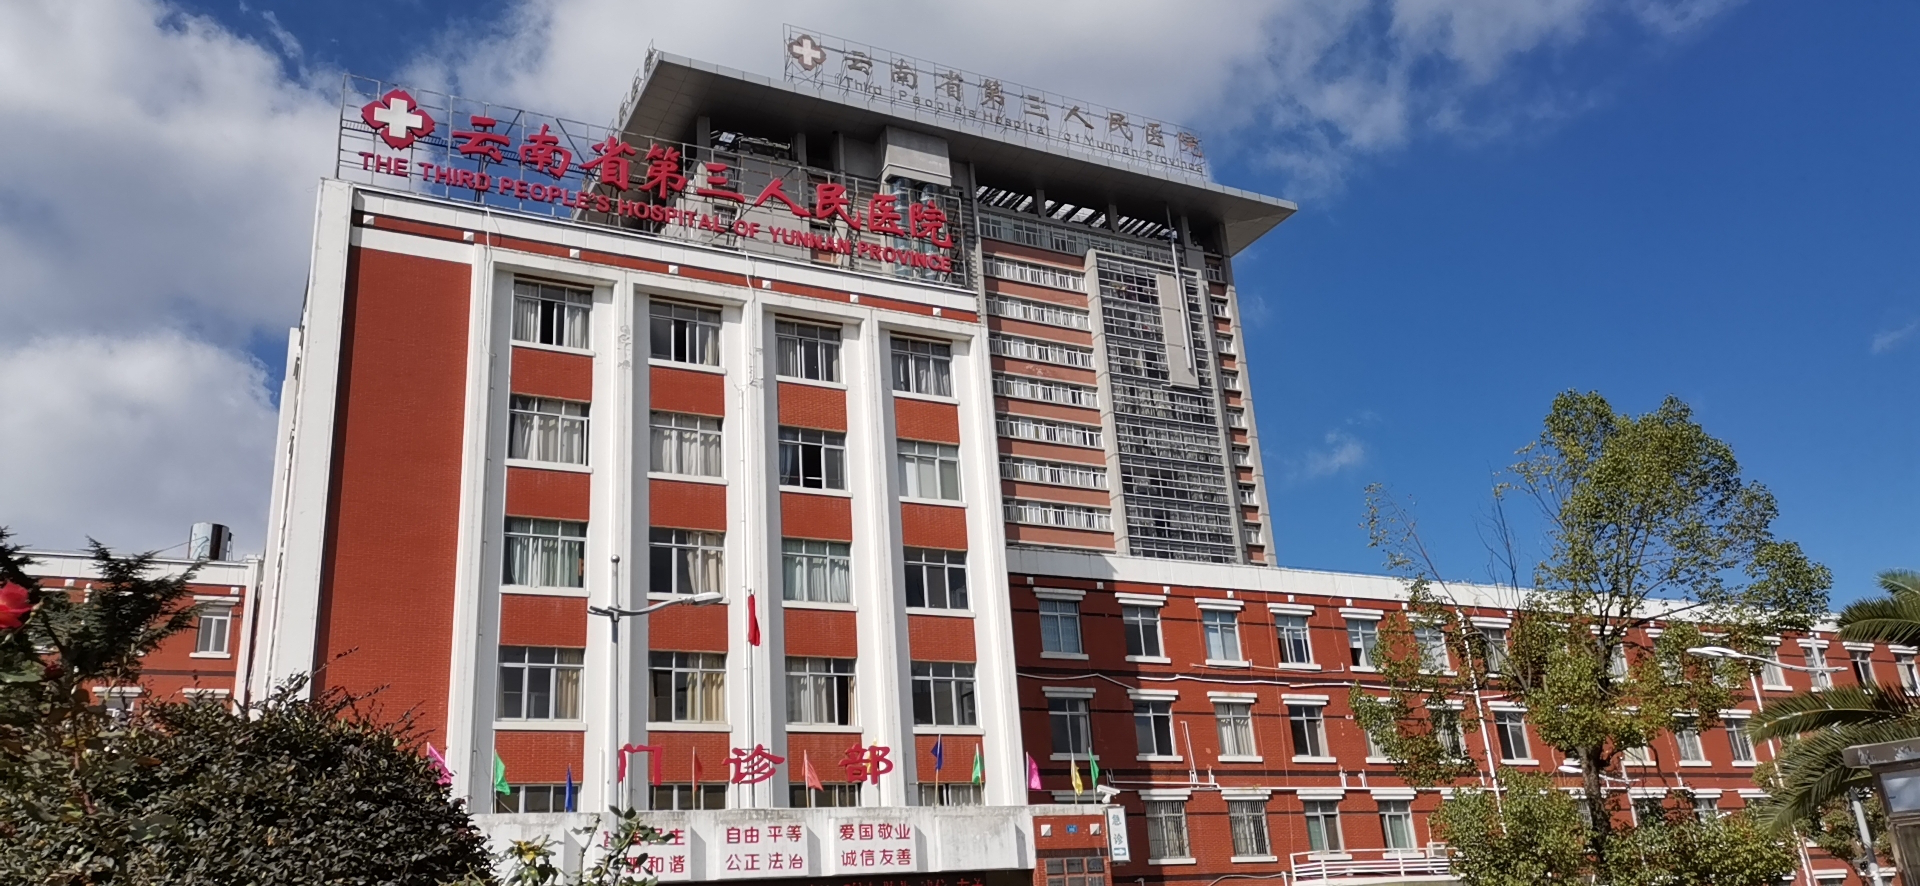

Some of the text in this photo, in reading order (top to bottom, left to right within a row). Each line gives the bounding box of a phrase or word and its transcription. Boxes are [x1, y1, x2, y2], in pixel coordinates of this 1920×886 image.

[843, 76, 882, 96] Third
[983, 110, 1049, 136] Hospital
[1064, 132, 1080, 144] of
[1083, 134, 1138, 158] Yunnan
[1145, 150, 1203, 174] Province
[844, 50, 1203, 158] 云南省第三人民医院
[358, 151, 953, 273] THE THIRD PEOPLE'S HOSPITAL OF YUNNAN PROVINCE
[452, 115, 953, 249] 云南省第三人民医院
[617, 743, 894, 786] 门诊部
[606, 854, 685, 875] 明和谐
[839, 823, 911, 841] 爱国敬业
[841, 848, 912, 867] 诚信友善
